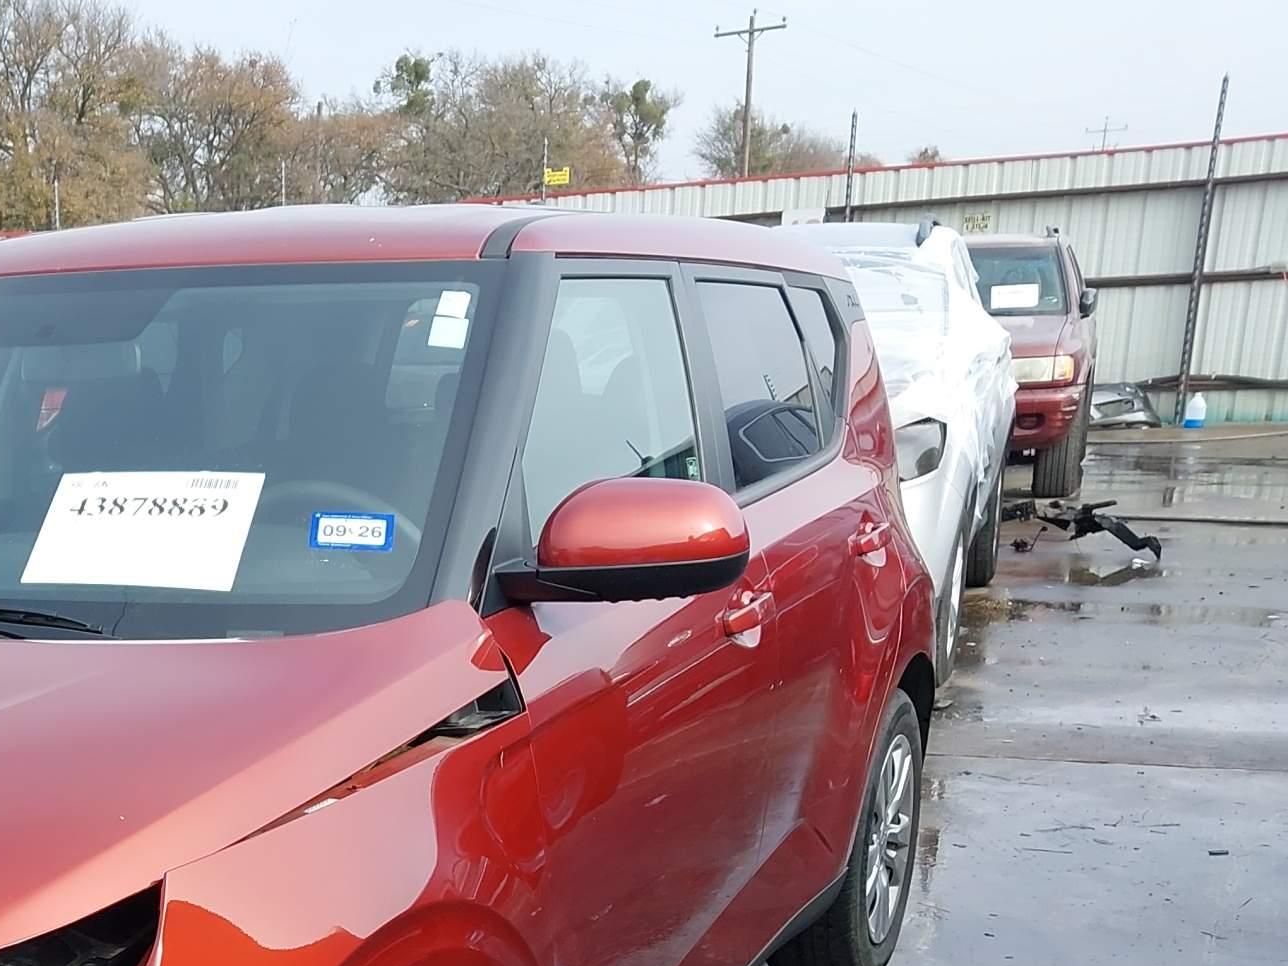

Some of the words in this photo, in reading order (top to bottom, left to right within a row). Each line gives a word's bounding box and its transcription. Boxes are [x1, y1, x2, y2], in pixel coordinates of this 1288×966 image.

[69, 496, 230, 517] 43878889
[322, 524, 348, 537] 09
[358, 525, 383, 539] 26
